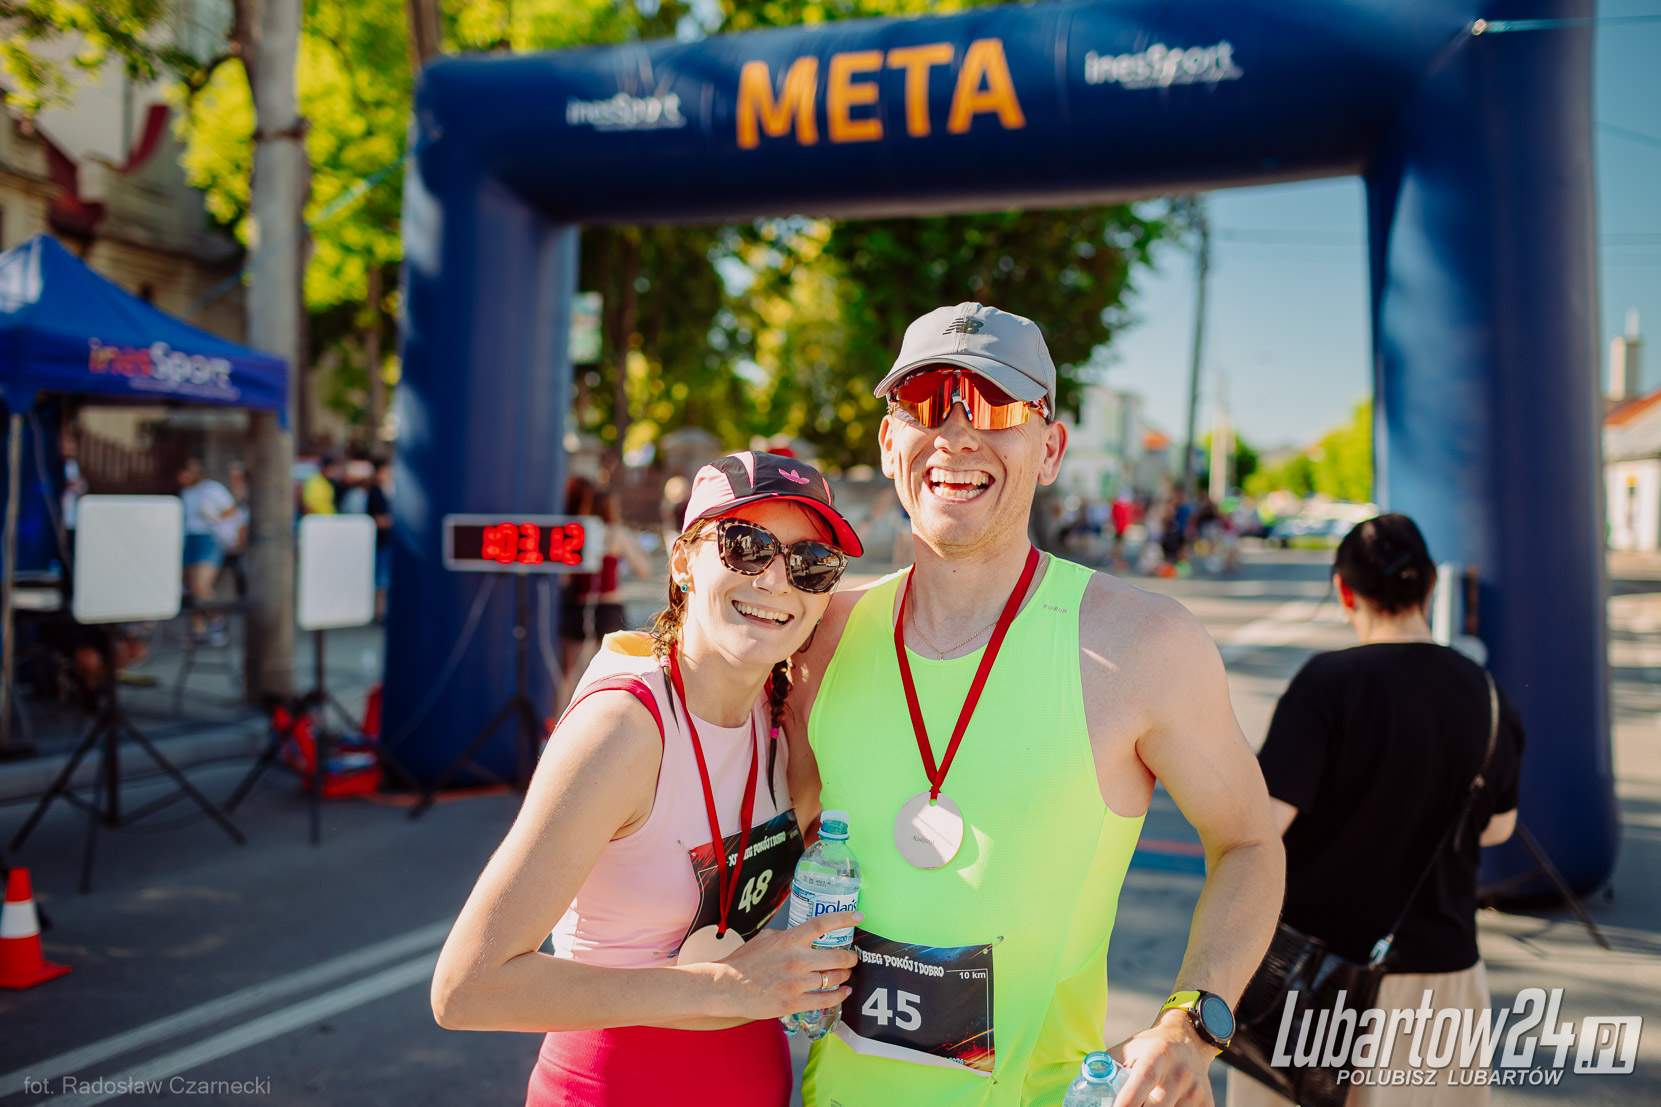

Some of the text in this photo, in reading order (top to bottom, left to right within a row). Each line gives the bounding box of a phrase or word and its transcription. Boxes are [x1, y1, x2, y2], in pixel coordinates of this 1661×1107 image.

[735, 38, 1026, 149] META
[738, 869, 773, 913] 48
[862, 950, 883, 965] BIEG
[883, 954, 914, 972] POKÓJ
[914, 961, 919, 973] I
[919, 962, 945, 978] DOBRO
[959, 971, 987, 980] 10 km
[861, 987, 922, 1031] 45
